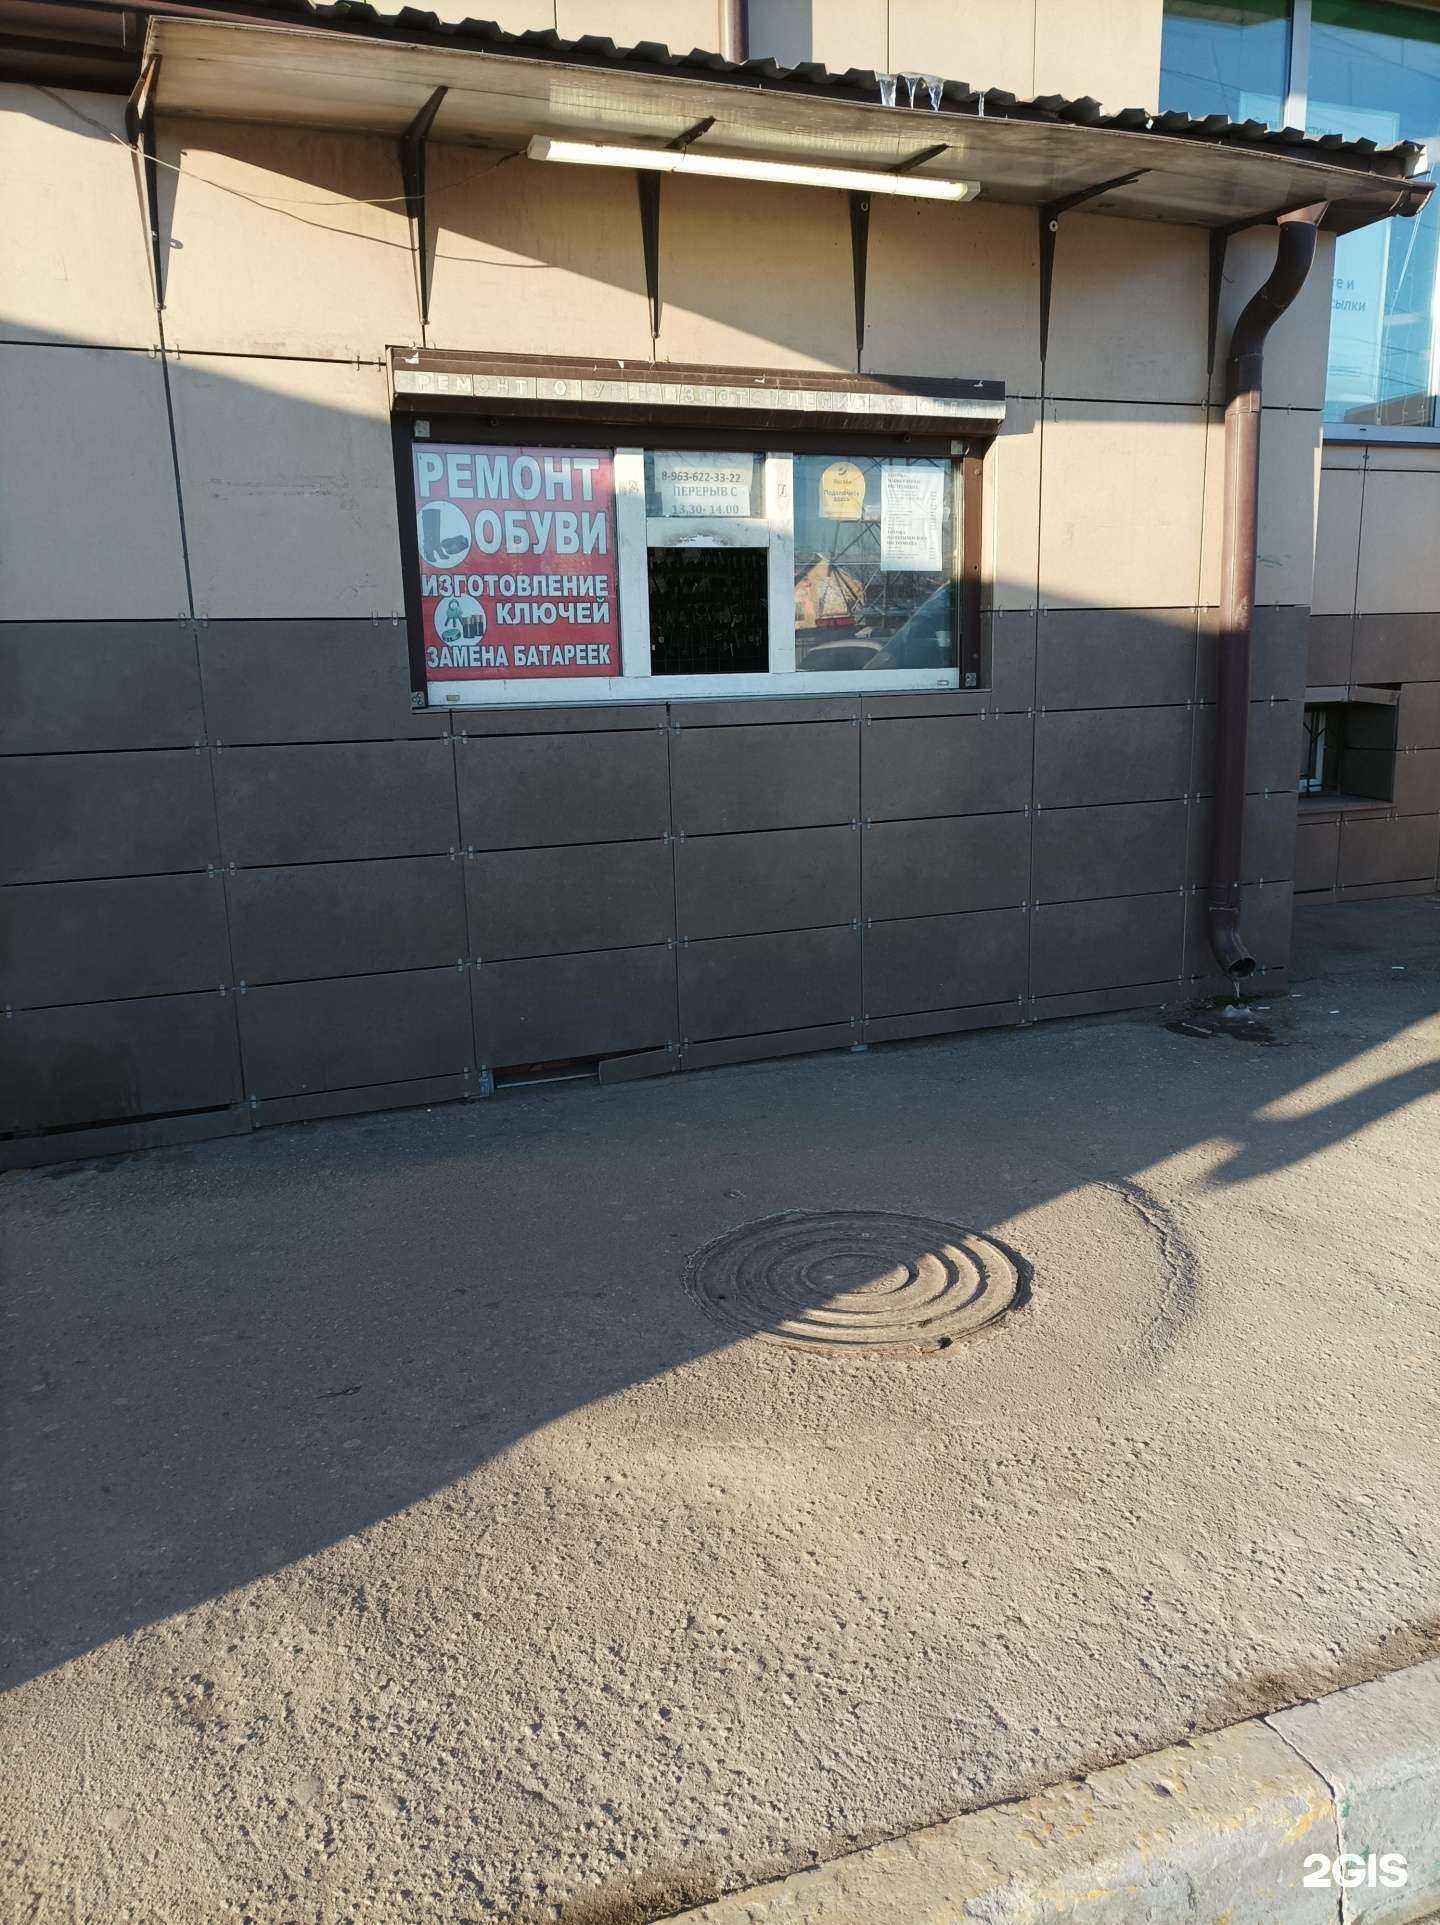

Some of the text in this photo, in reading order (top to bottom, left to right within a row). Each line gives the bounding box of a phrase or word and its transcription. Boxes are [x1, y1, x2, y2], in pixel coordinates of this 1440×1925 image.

[416, 452, 600, 501] РЕМОНТ
[661, 471, 741, 483] 8-963-622-33-22
[672, 485, 738, 497] ПЕРЕРЫВ С
[475, 509, 607, 555] ОБУВИ
[421, 574, 609, 597] ИЗГОТОВЛЕНИЕ
[496, 596, 611, 624] КЛЮЧЕЙ
[426, 643, 611, 667] ЗАМЕНА БАТАРЕЕК
